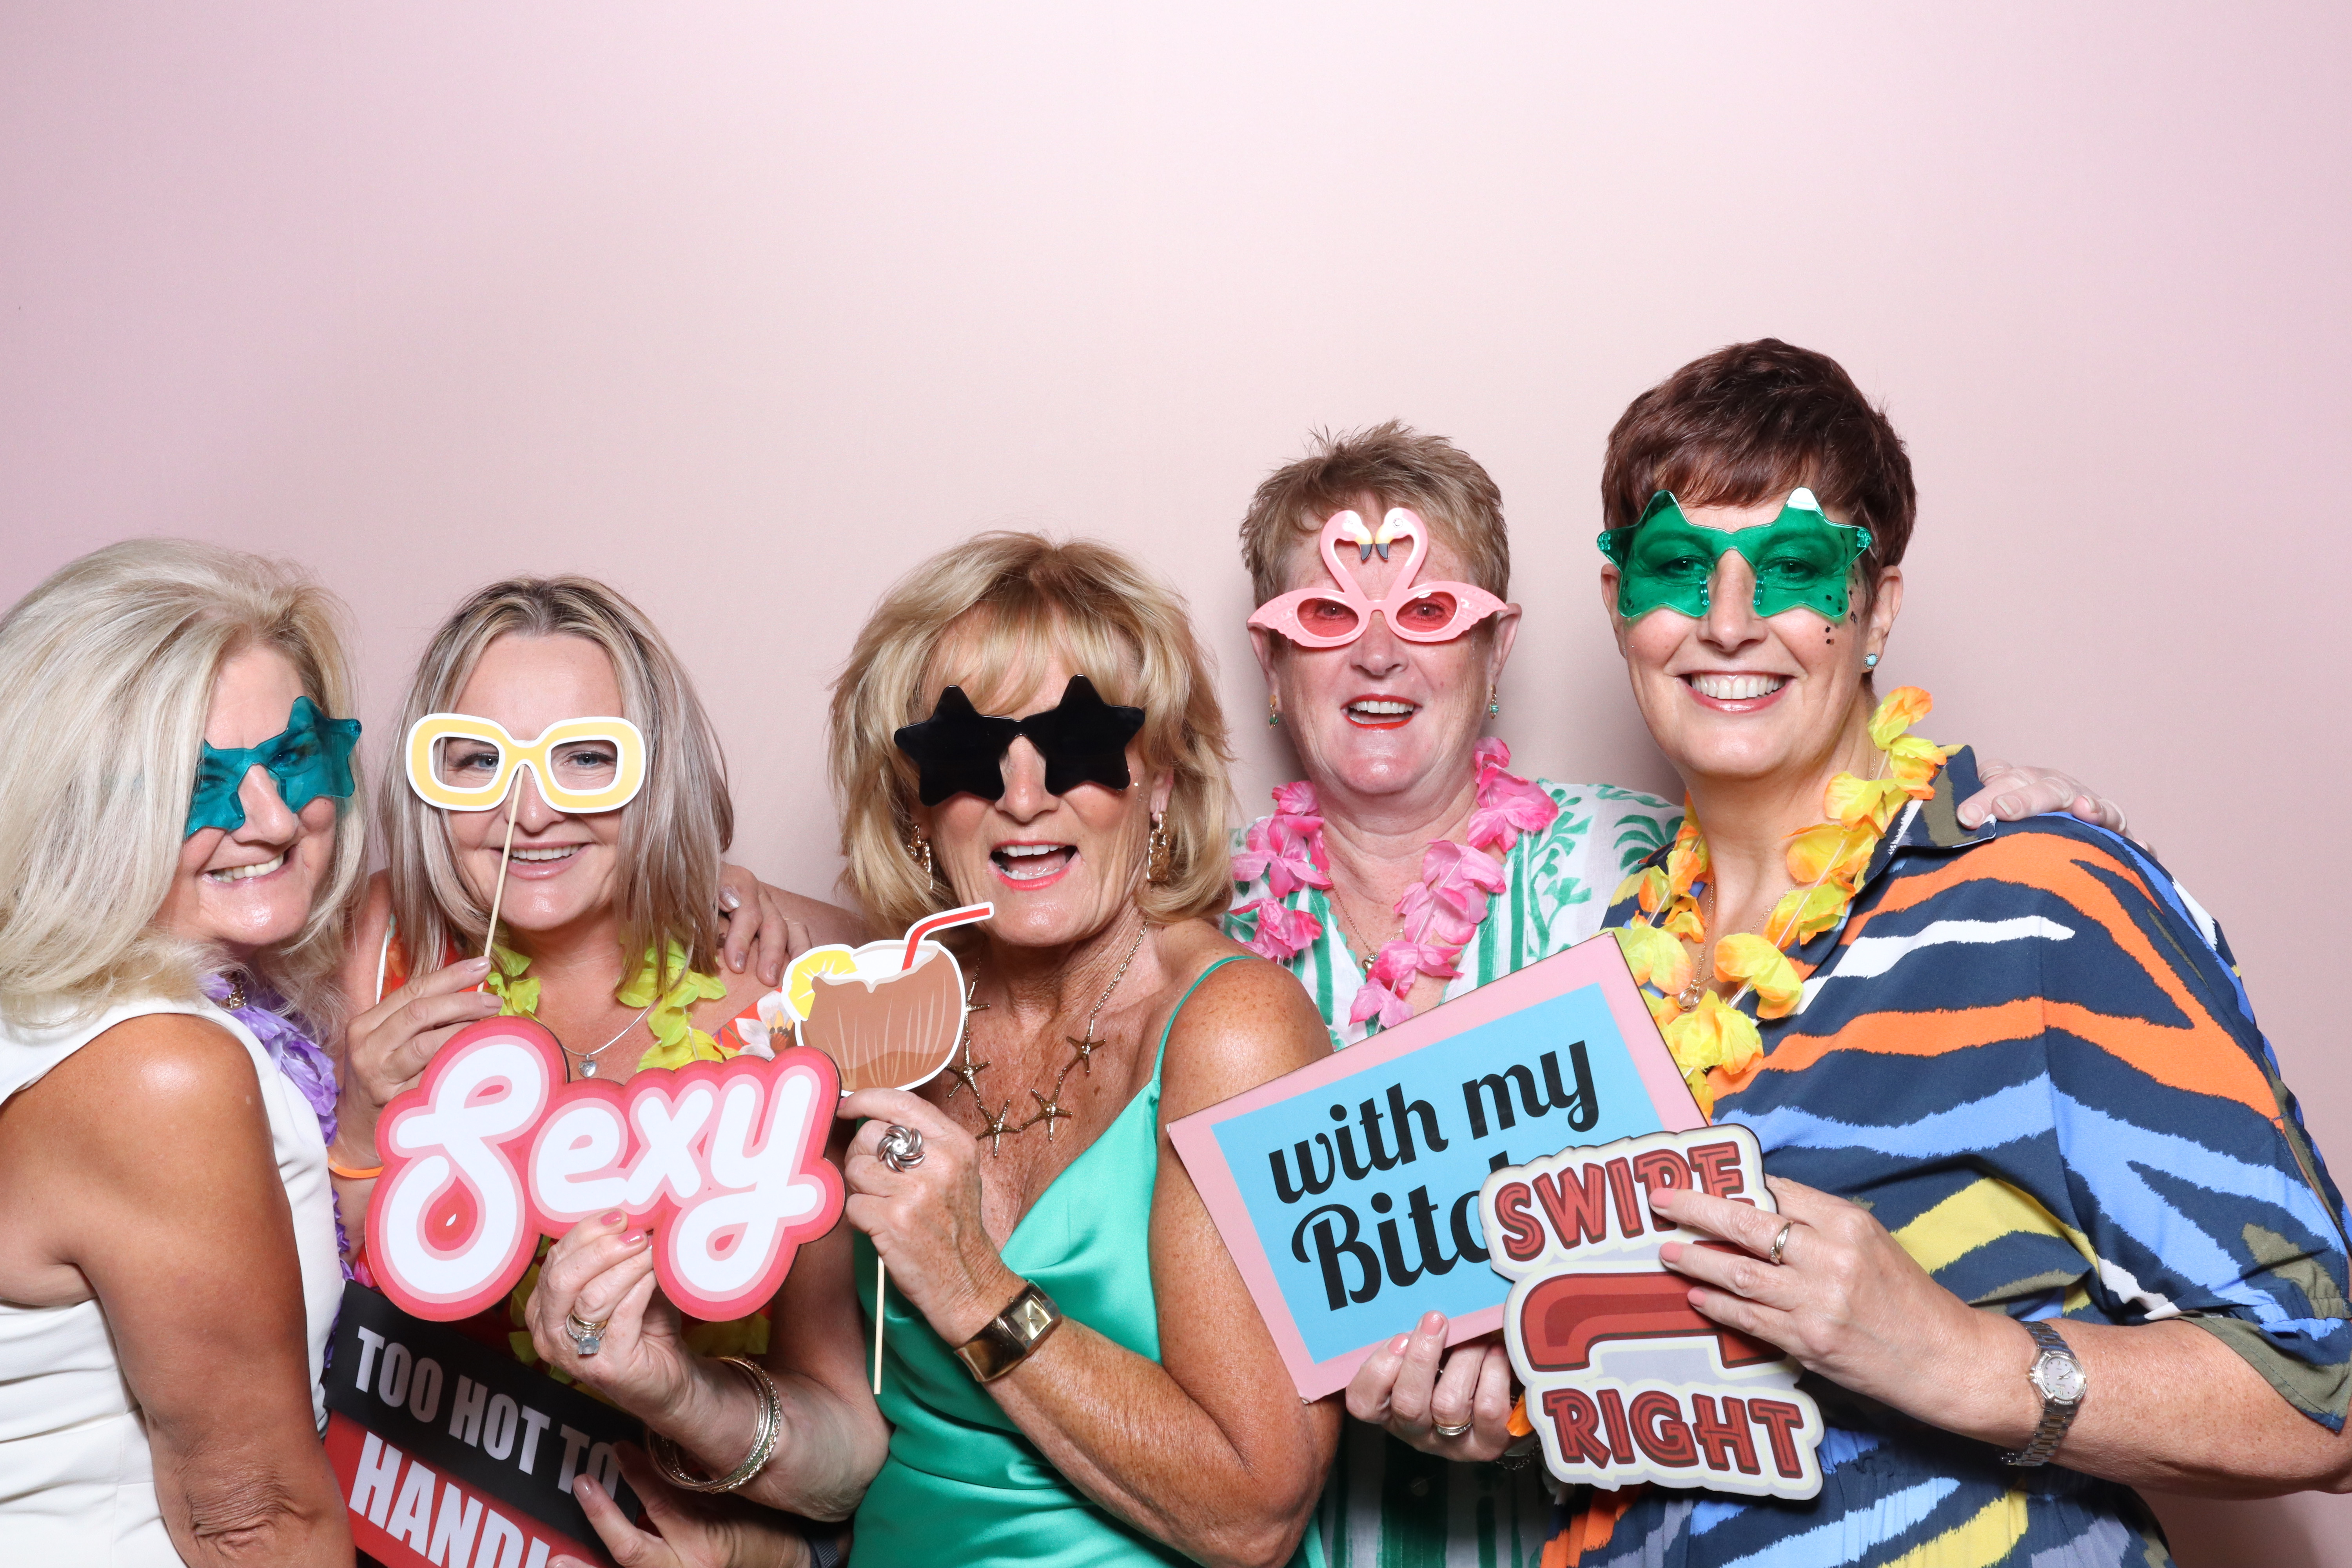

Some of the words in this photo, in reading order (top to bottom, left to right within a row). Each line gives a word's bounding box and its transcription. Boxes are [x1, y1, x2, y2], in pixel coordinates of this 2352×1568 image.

[386, 1043, 818, 1295] Sexy
[1268, 1082, 1448, 1203] with
[1463, 1040, 1599, 1141] my
[1494, 1141, 1755, 1261] SWIPE
[1291, 1150, 1510, 1311] Bitc
[355, 1325, 443, 1423] TOO
[448, 1374, 551, 1475] HOT
[557, 1424, 621, 1501] TO
[1542, 1388, 1804, 1479] RIGHT
